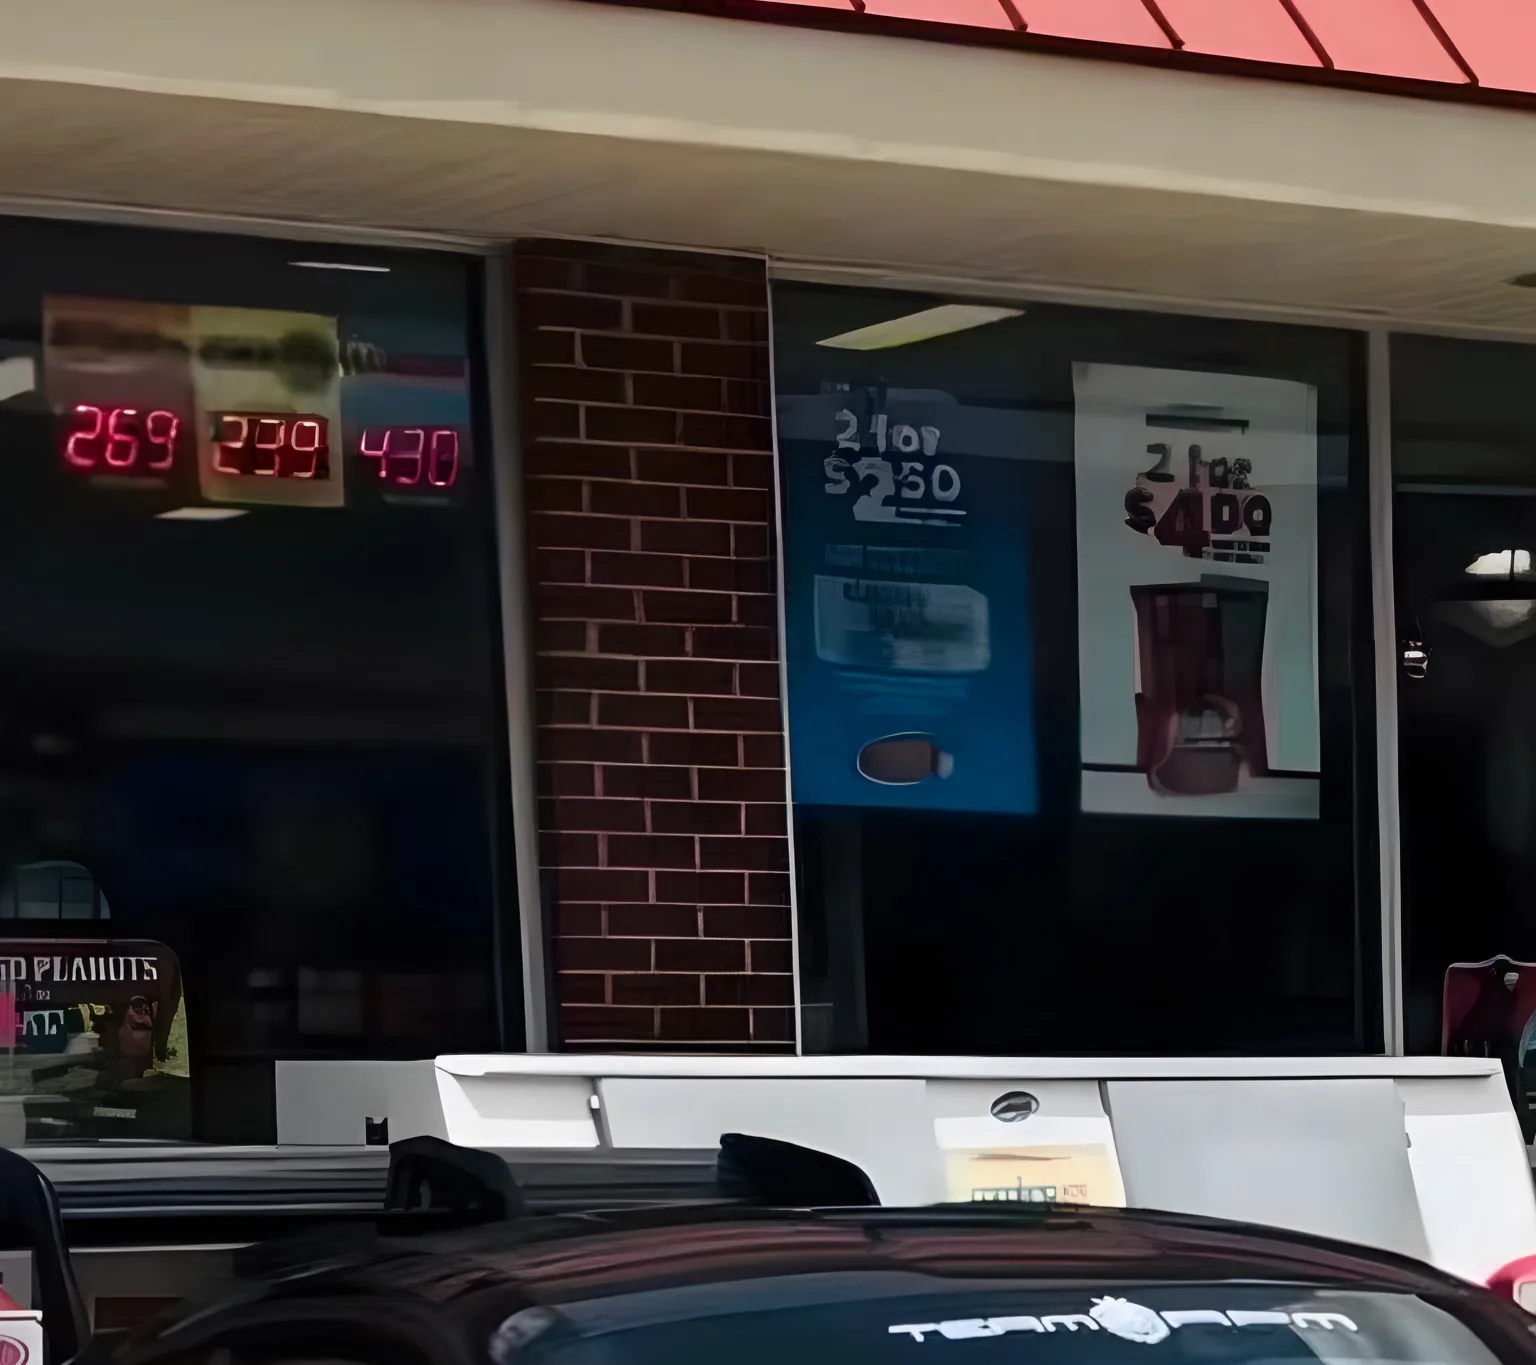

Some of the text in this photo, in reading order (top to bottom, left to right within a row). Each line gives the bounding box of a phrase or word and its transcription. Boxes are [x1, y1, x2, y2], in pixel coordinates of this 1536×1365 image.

[65, 404, 181, 470] 269
[835, 408, 861, 451] 2
[358, 427, 459, 487] 430
[1146, 442, 1175, 483] 2
